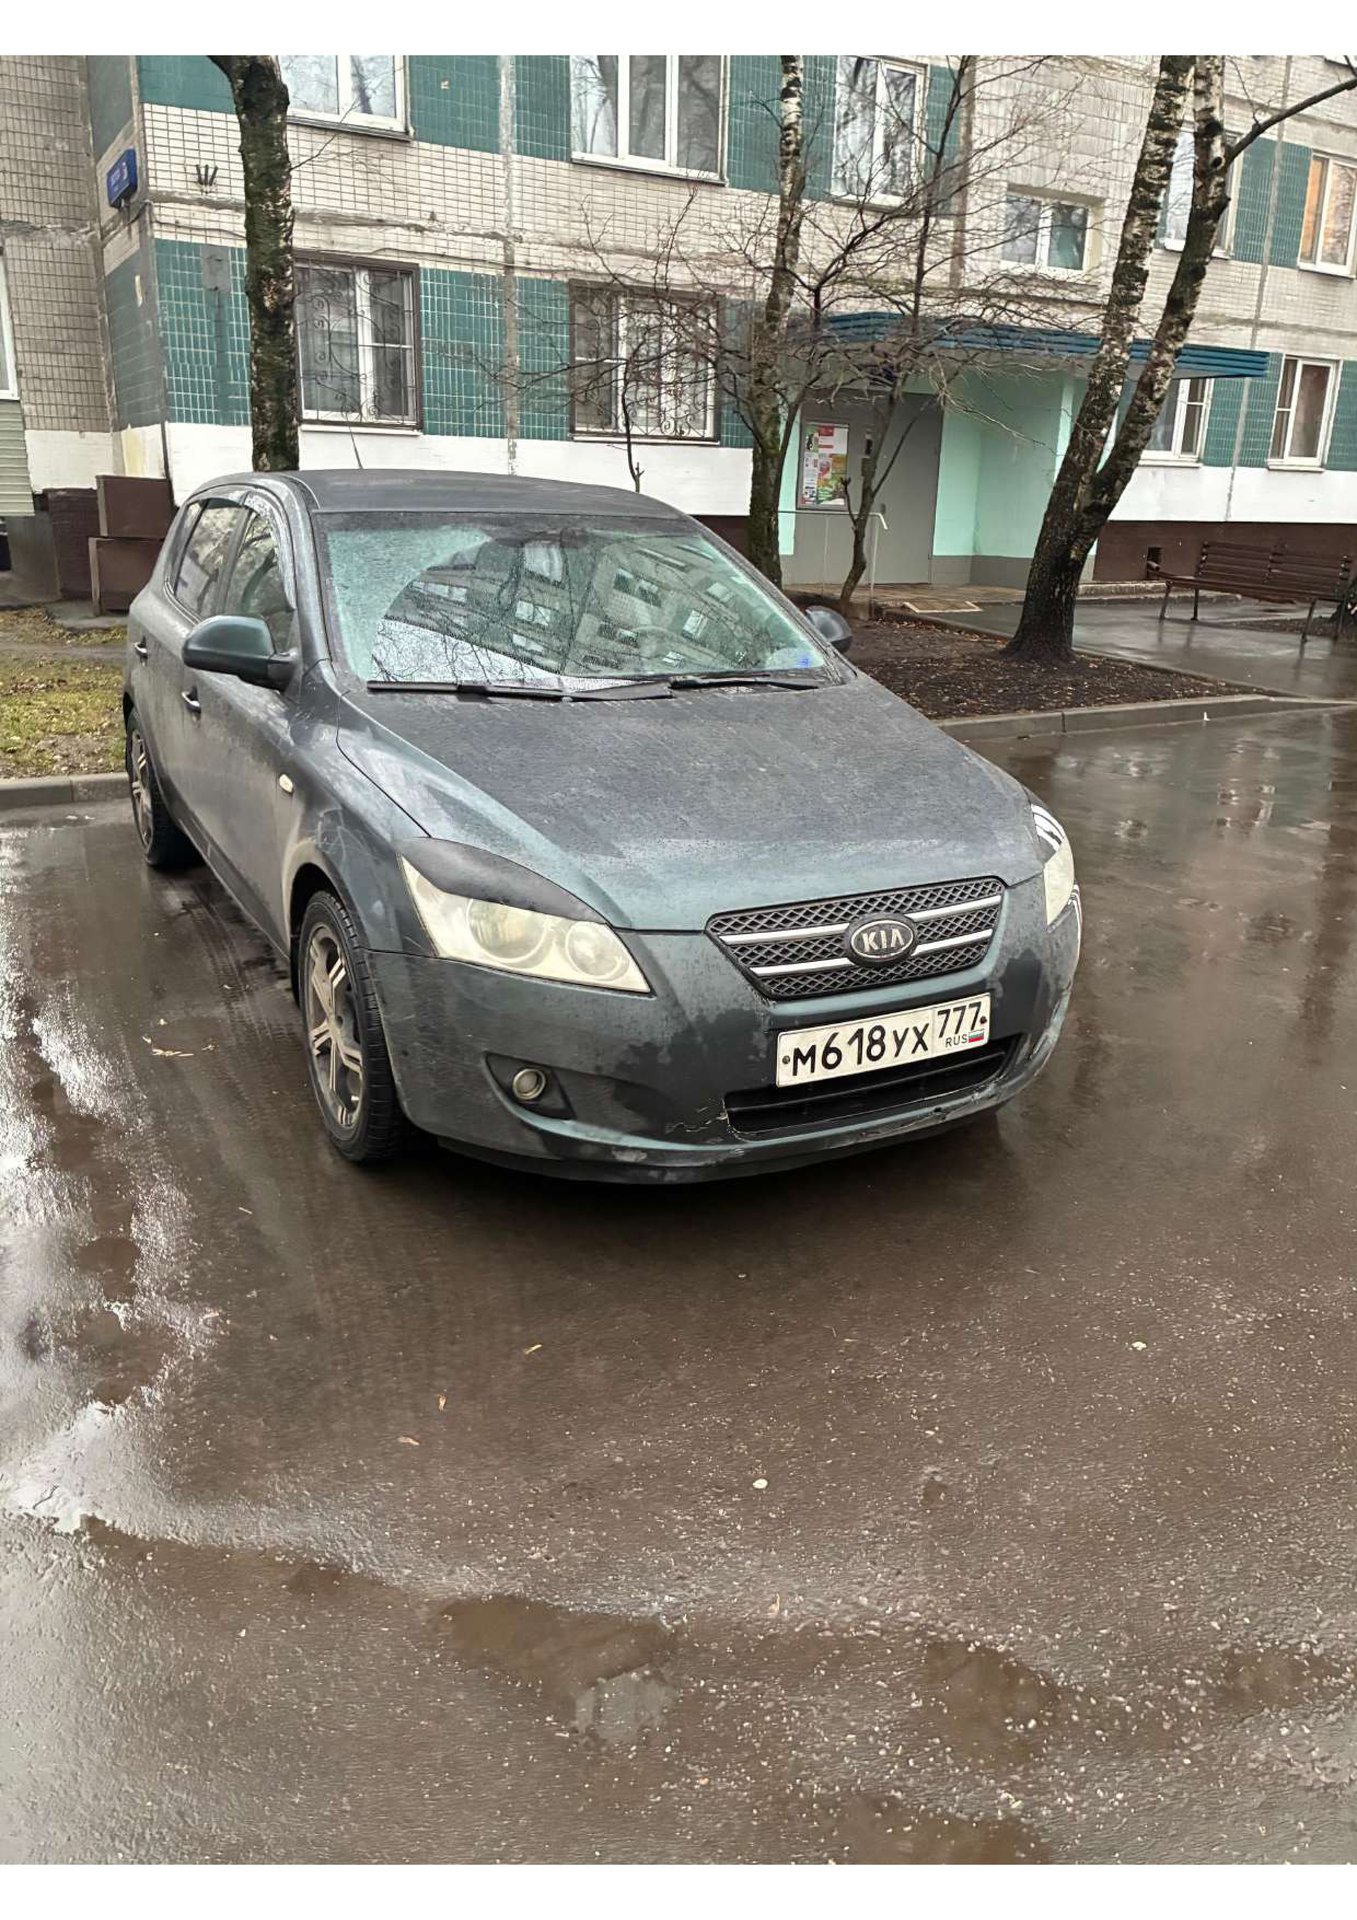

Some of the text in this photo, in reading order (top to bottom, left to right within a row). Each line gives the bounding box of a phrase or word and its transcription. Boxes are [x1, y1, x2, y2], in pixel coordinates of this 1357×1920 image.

[861, 928, 905, 953] KIA
[937, 1001, 982, 1038] 777
[945, 1033, 968, 1048] RUS
